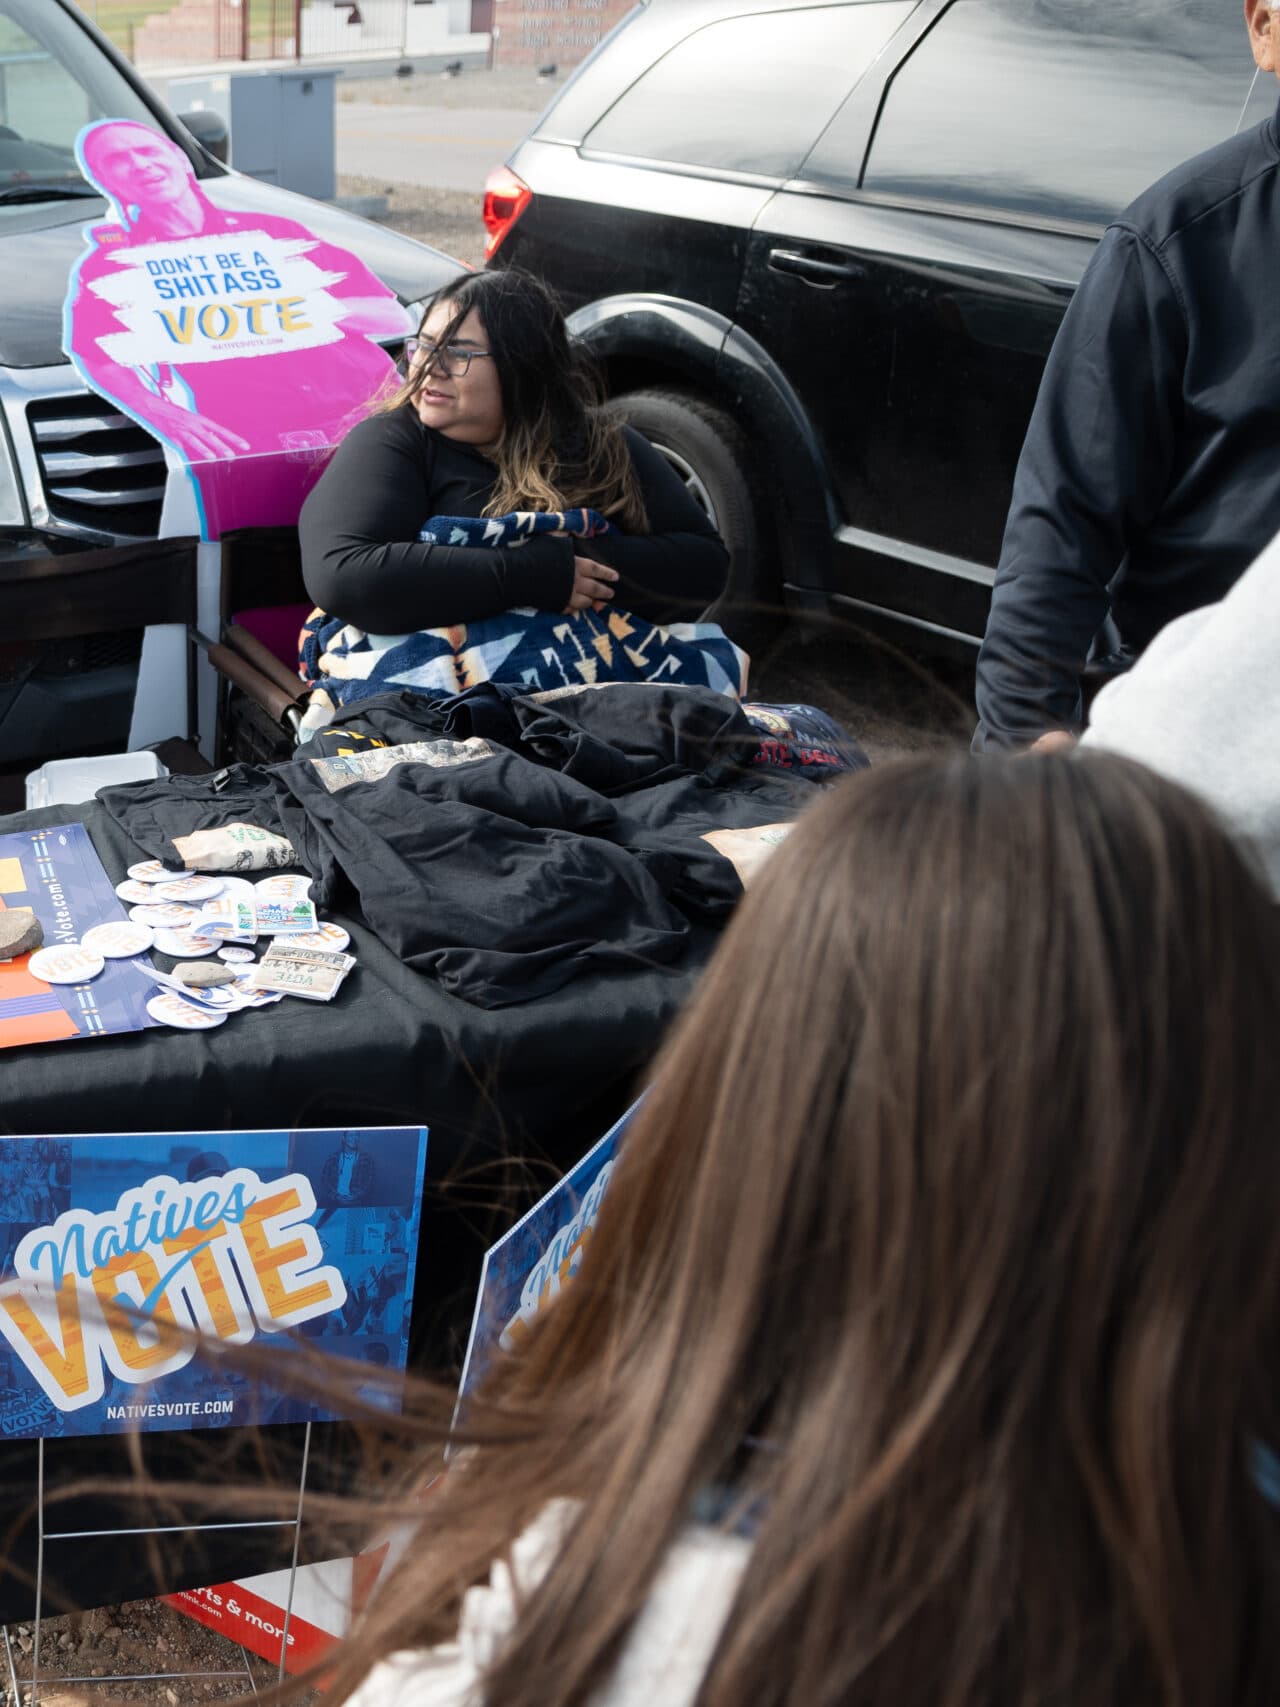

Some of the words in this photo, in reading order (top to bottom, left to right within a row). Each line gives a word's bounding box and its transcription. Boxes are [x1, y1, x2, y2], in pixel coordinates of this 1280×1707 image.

[146, 254, 209, 276] DON'T
[215, 252, 247, 270] BE
[253, 251, 269, 266] A
[154, 269, 281, 300] SHITASS
[153, 296, 313, 344] VOTE
[30, 1183, 257, 1290] Natives
[0, 1188, 333, 1398] VOTE
[4, 1412, 44, 1431] VOT
[107, 1400, 234, 1420] NATIVESVOTE.COM
[192, 1587, 222, 1606] rts
[226, 1599, 242, 1616] &
[245, 1611, 295, 1646] more
